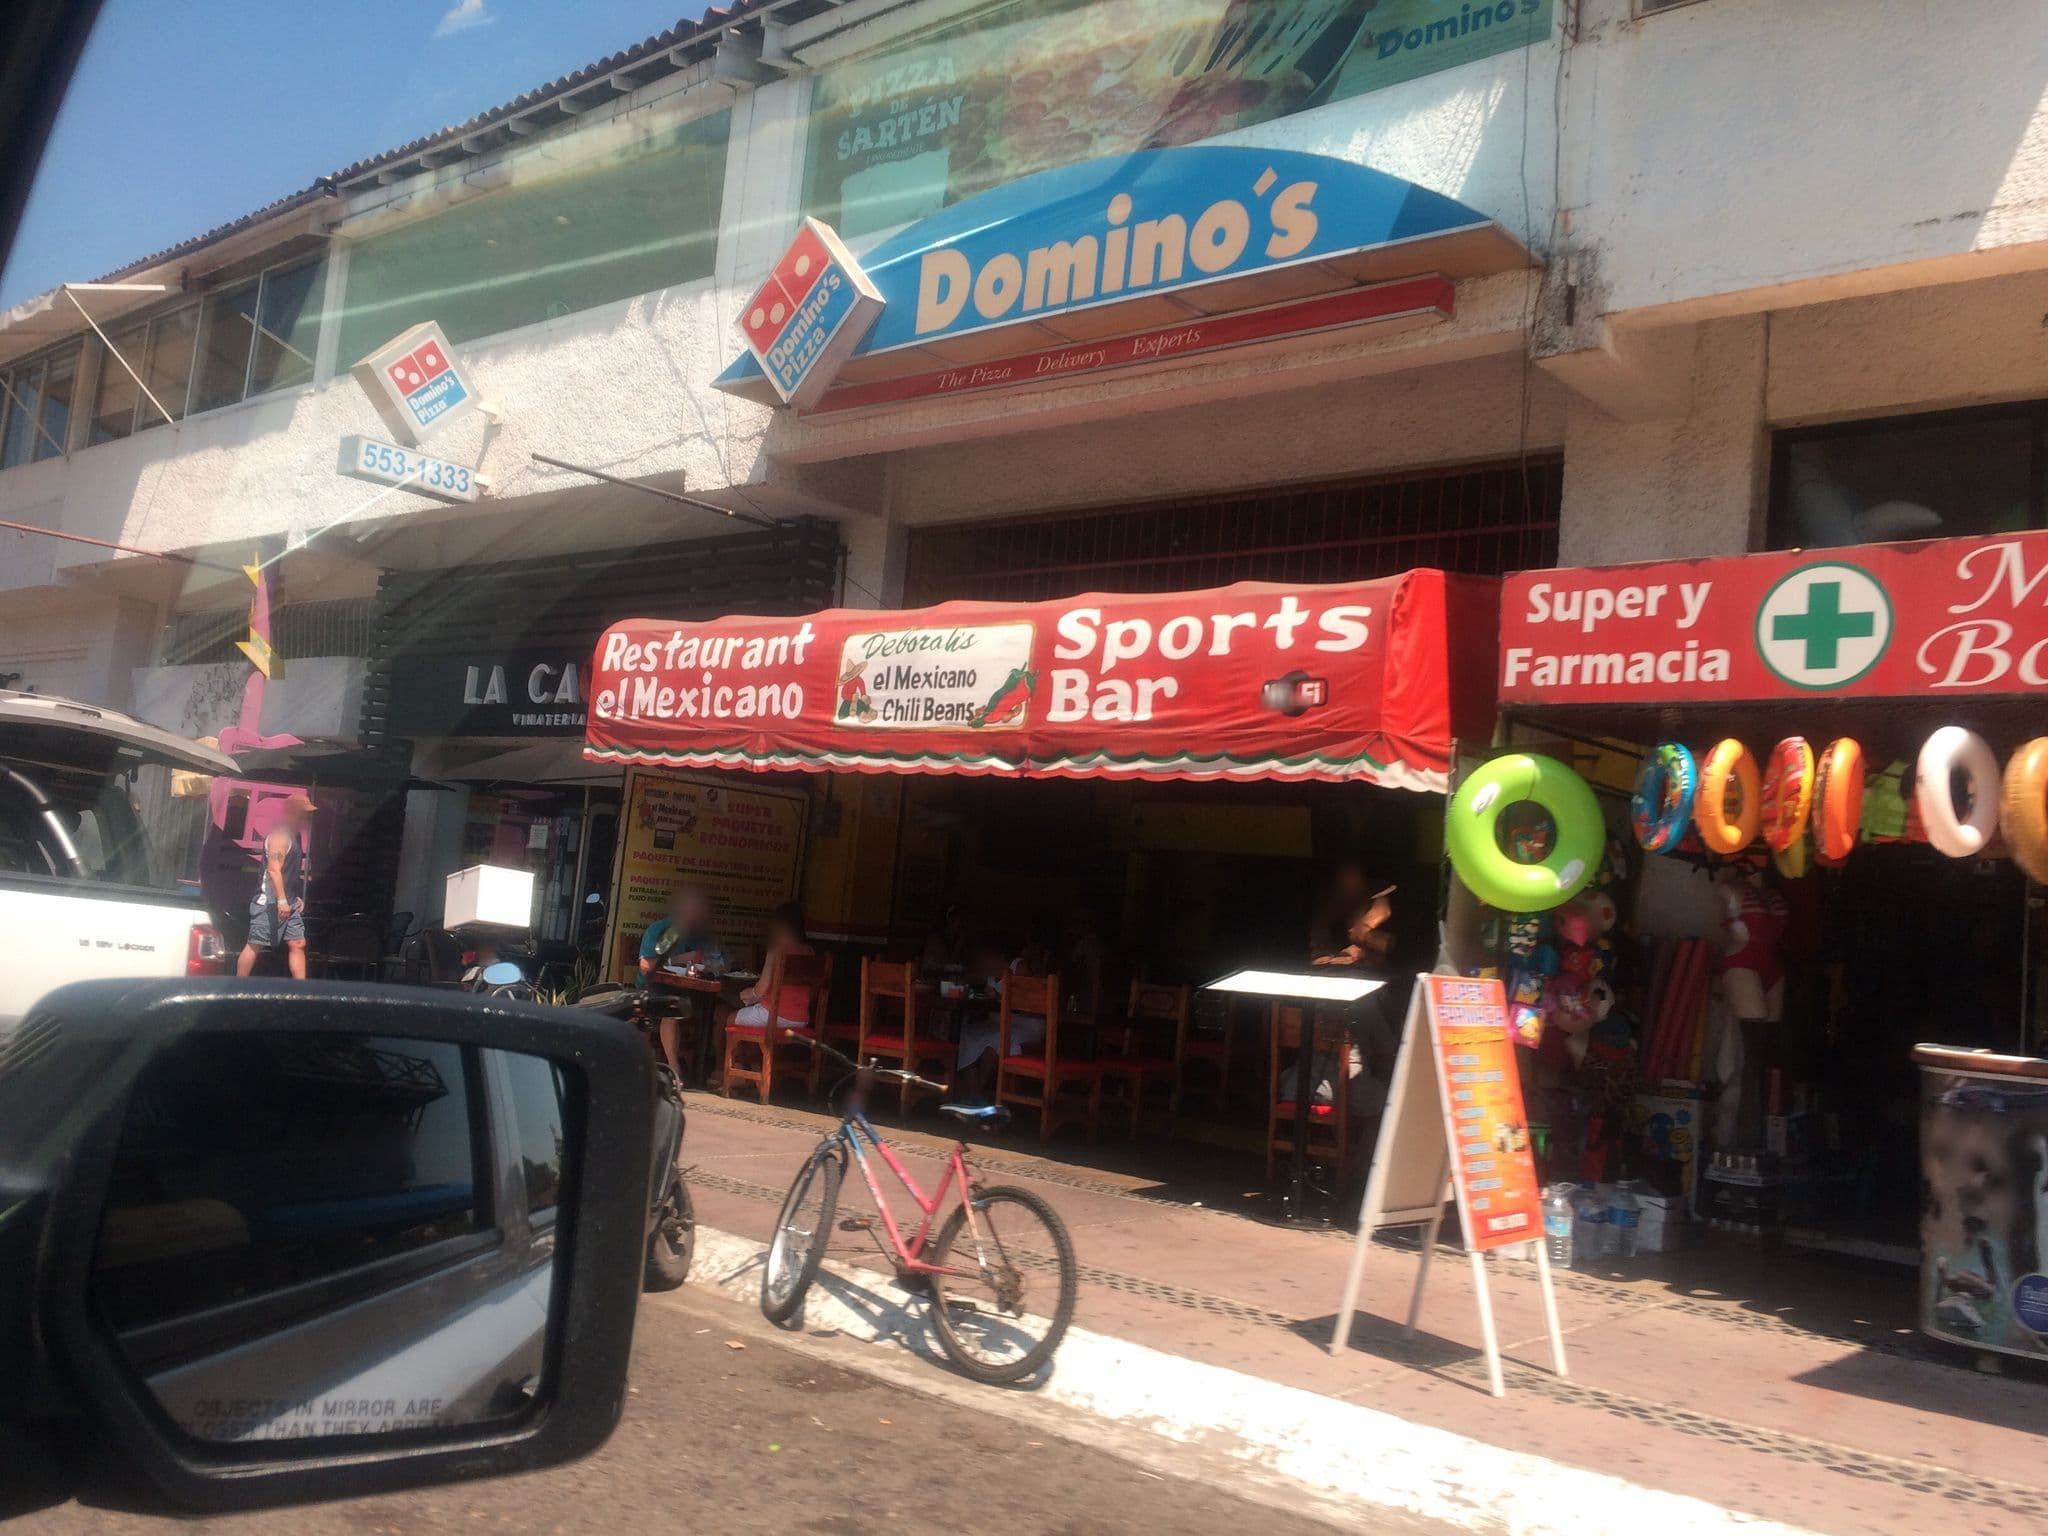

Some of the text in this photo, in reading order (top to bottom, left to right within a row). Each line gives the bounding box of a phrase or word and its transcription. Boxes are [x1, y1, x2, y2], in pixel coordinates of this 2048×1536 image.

[848, 56, 956, 119] PIZZA
[890, 97, 909, 115] DE
[837, 95, 964, 161] SARTÉN
[914, 167, 1319, 335] Domino's
[770, 274, 841, 370] Domino's
[781, 327, 825, 387] Pizza
[936, 327, 1201, 390] The Pizza Delivery Experts
[410, 375, 455, 410] Domino's
[417, 400, 447, 423] Pizza
[363, 443, 470, 493] 553-1333
[1525, 581, 1713, 632] Super y
[601, 622, 817, 672] Restaurant
[1053, 597, 1373, 674] Sports
[463, 662, 580, 705] LA CA
[873, 664, 978, 691] el Mexicano
[1503, 641, 1731, 688] Farmacia
[595, 672, 804, 720] el Mexicano
[882, 697, 974, 723] Chili Beans
[1046, 669, 1178, 723] Bar
[632, 850, 681, 867] PAQUETE
[295, 1398, 313, 1417] IN
[321, 1398, 396, 1417] MIRROR
[403, 1397, 442, 1417] ARE
[321, 1418, 368, 1436] THEY
